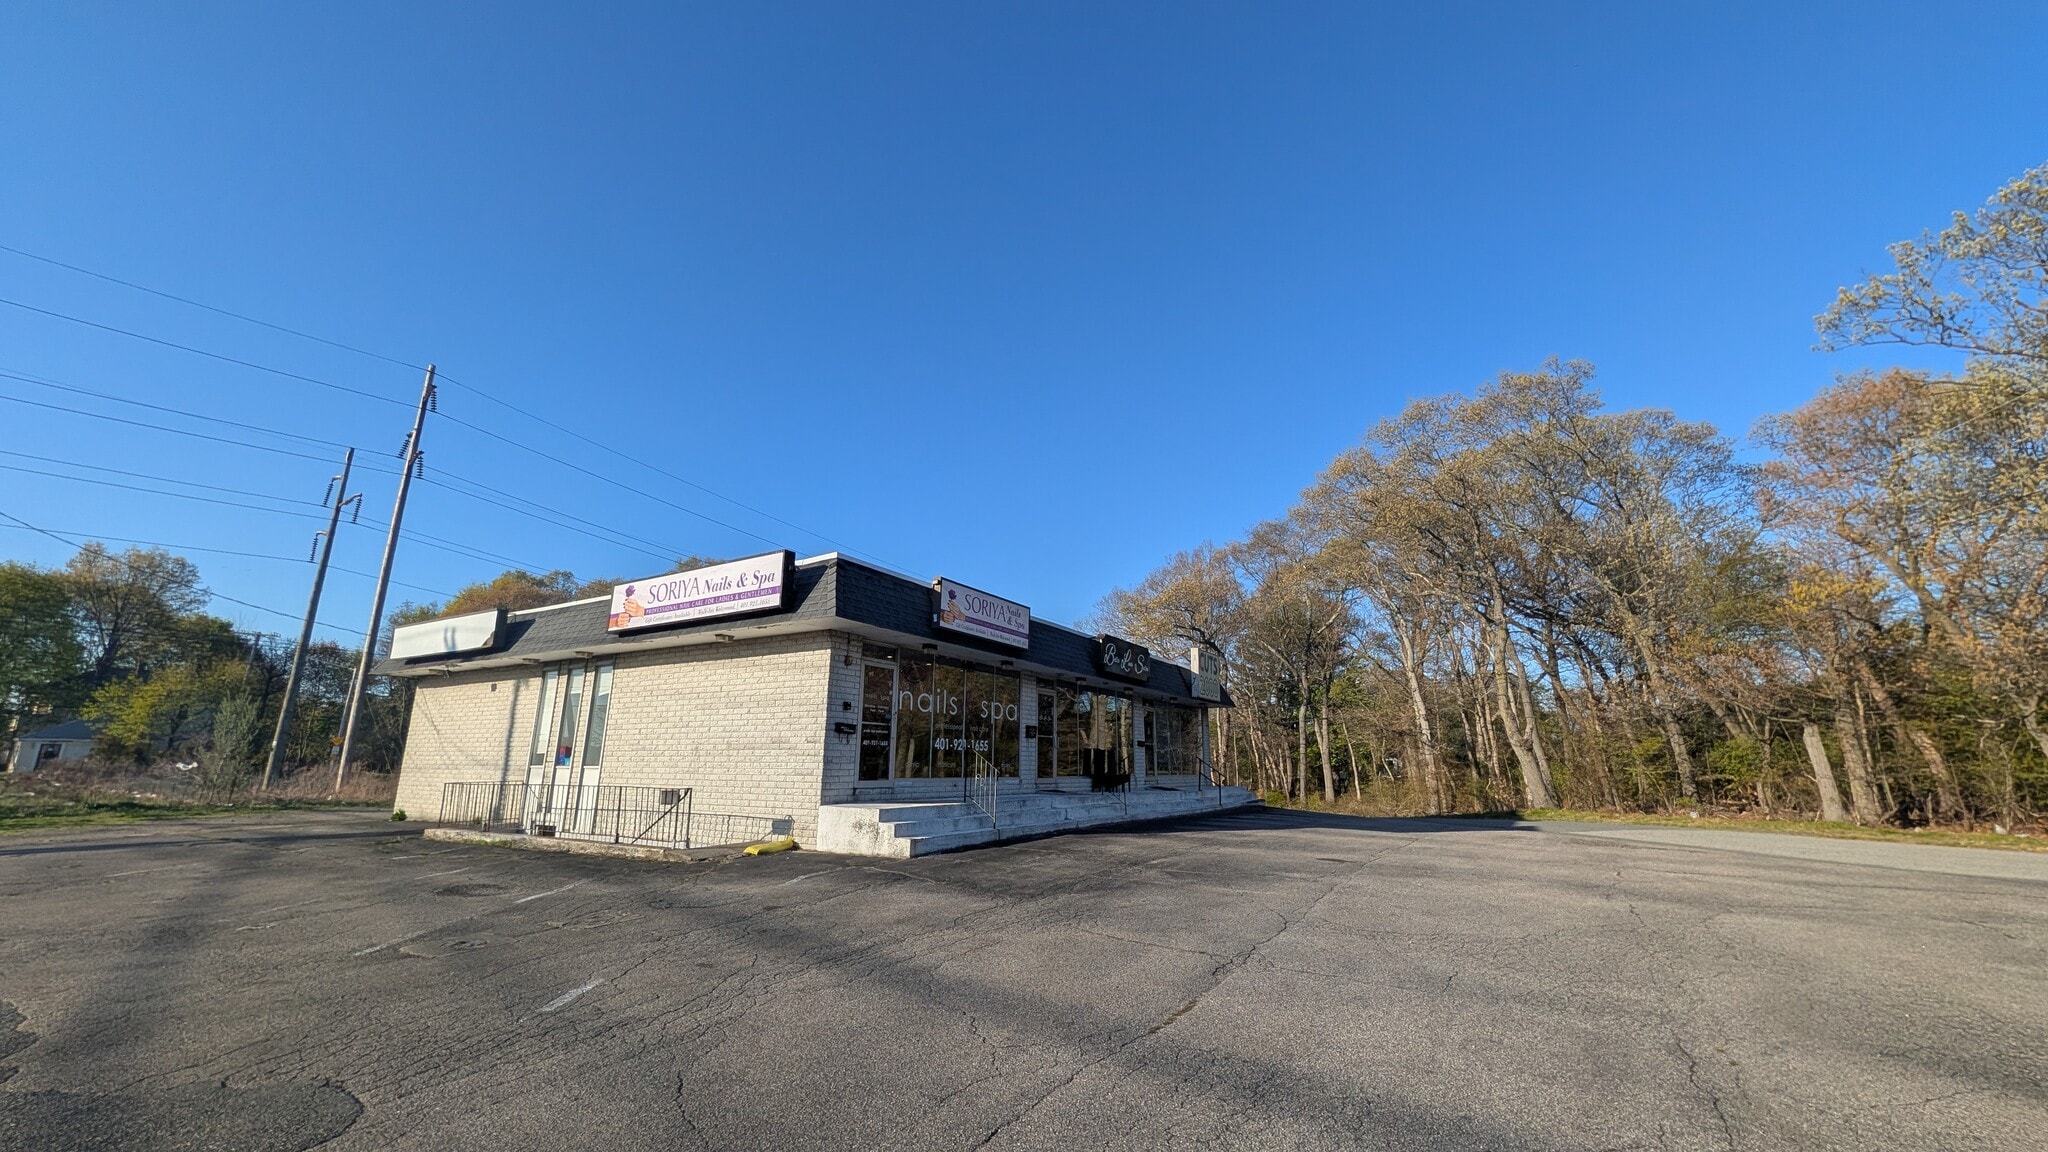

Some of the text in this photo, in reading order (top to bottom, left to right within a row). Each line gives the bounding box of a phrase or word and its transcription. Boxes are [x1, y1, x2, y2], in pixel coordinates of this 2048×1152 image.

[647, 570, 775, 604] SORIYA Nails & Spa
[691, 600, 703, 608] CARE
[715, 595, 734, 603] LADIES
[740, 589, 772, 599] GENTLEMEN
[964, 594, 1006, 622] SORIYA
[1006, 605, 1021, 619] Nails
[1014, 618, 1025, 631] Spa
[1200, 652, 1218, 676] CUTS
[899, 688, 958, 715] nails
[980, 700, 1017, 725] spa
[934, 737, 989, 751] 401-921-1655
